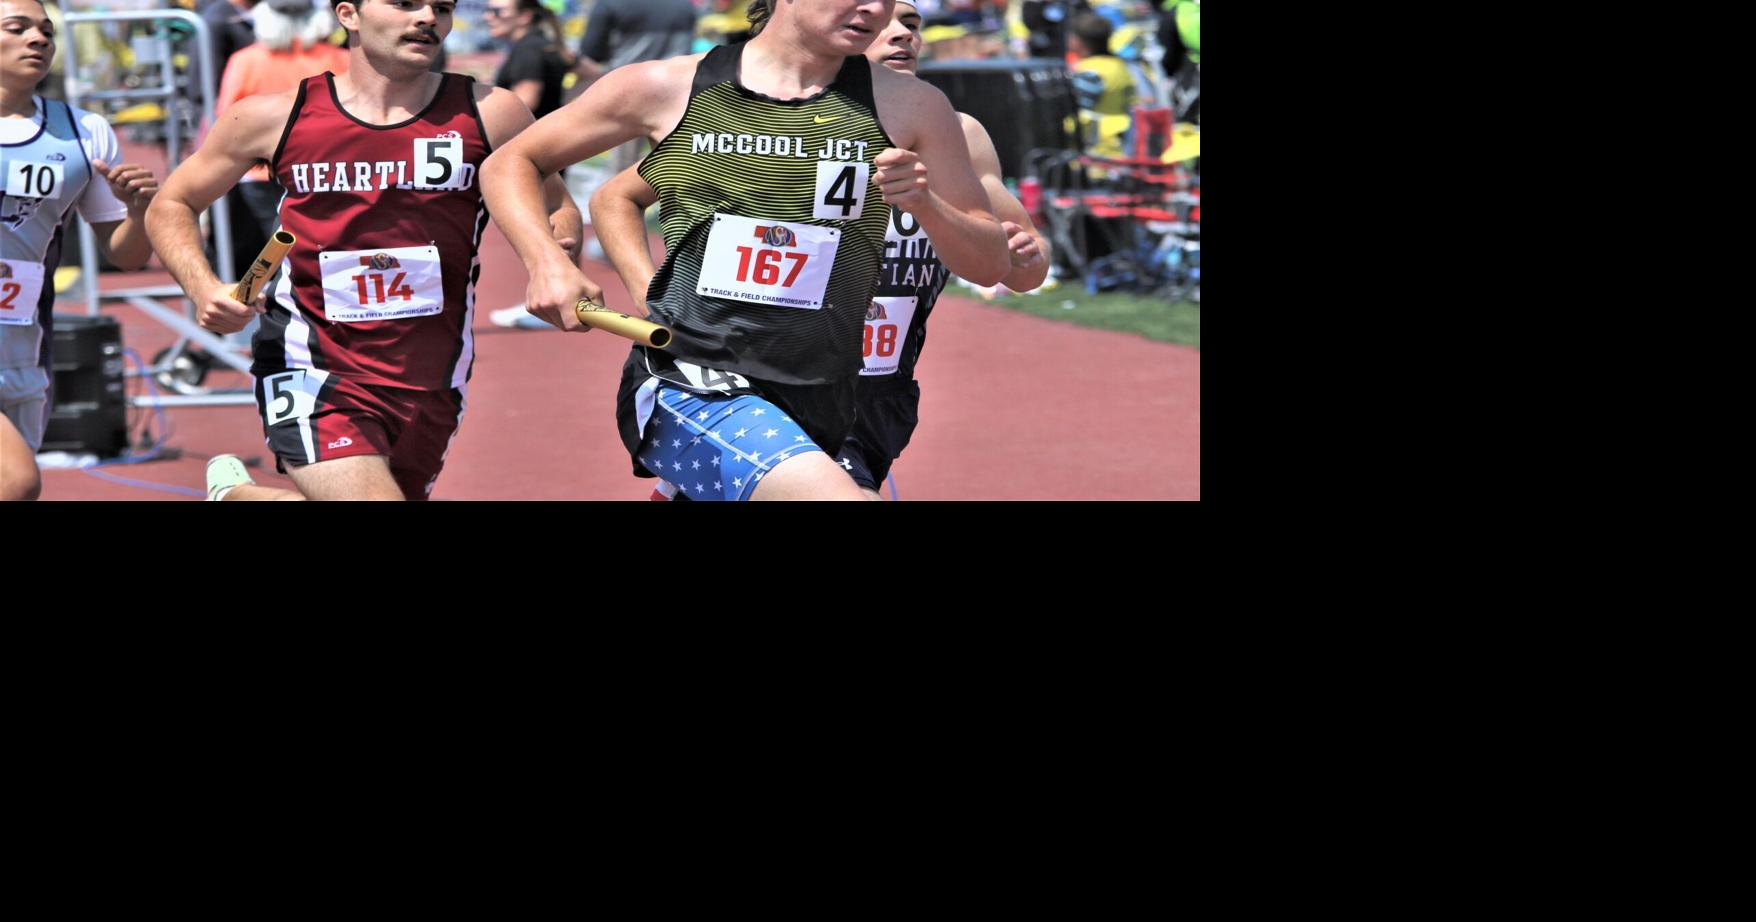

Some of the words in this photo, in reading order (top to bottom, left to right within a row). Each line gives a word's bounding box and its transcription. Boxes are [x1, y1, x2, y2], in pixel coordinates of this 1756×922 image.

[426, 141, 452, 185] 5
[691, 133, 808, 158] MCCOOL
[818, 138, 868, 161] JCT
[20, 164, 55, 196] 10
[291, 160, 475, 192] HEARTLD
[824, 166, 857, 216] 4
[736, 246, 809, 288] 167
[877, 263, 935, 287] IAN
[0, 282, 21, 310] 2
[352, 272, 414, 304] 114
[710, 288, 732, 297] TRACK
[741, 292, 761, 301] FIELD
[762, 295, 811, 306] CHAMPIONSHIPS
[272, 374, 295, 419] 5
